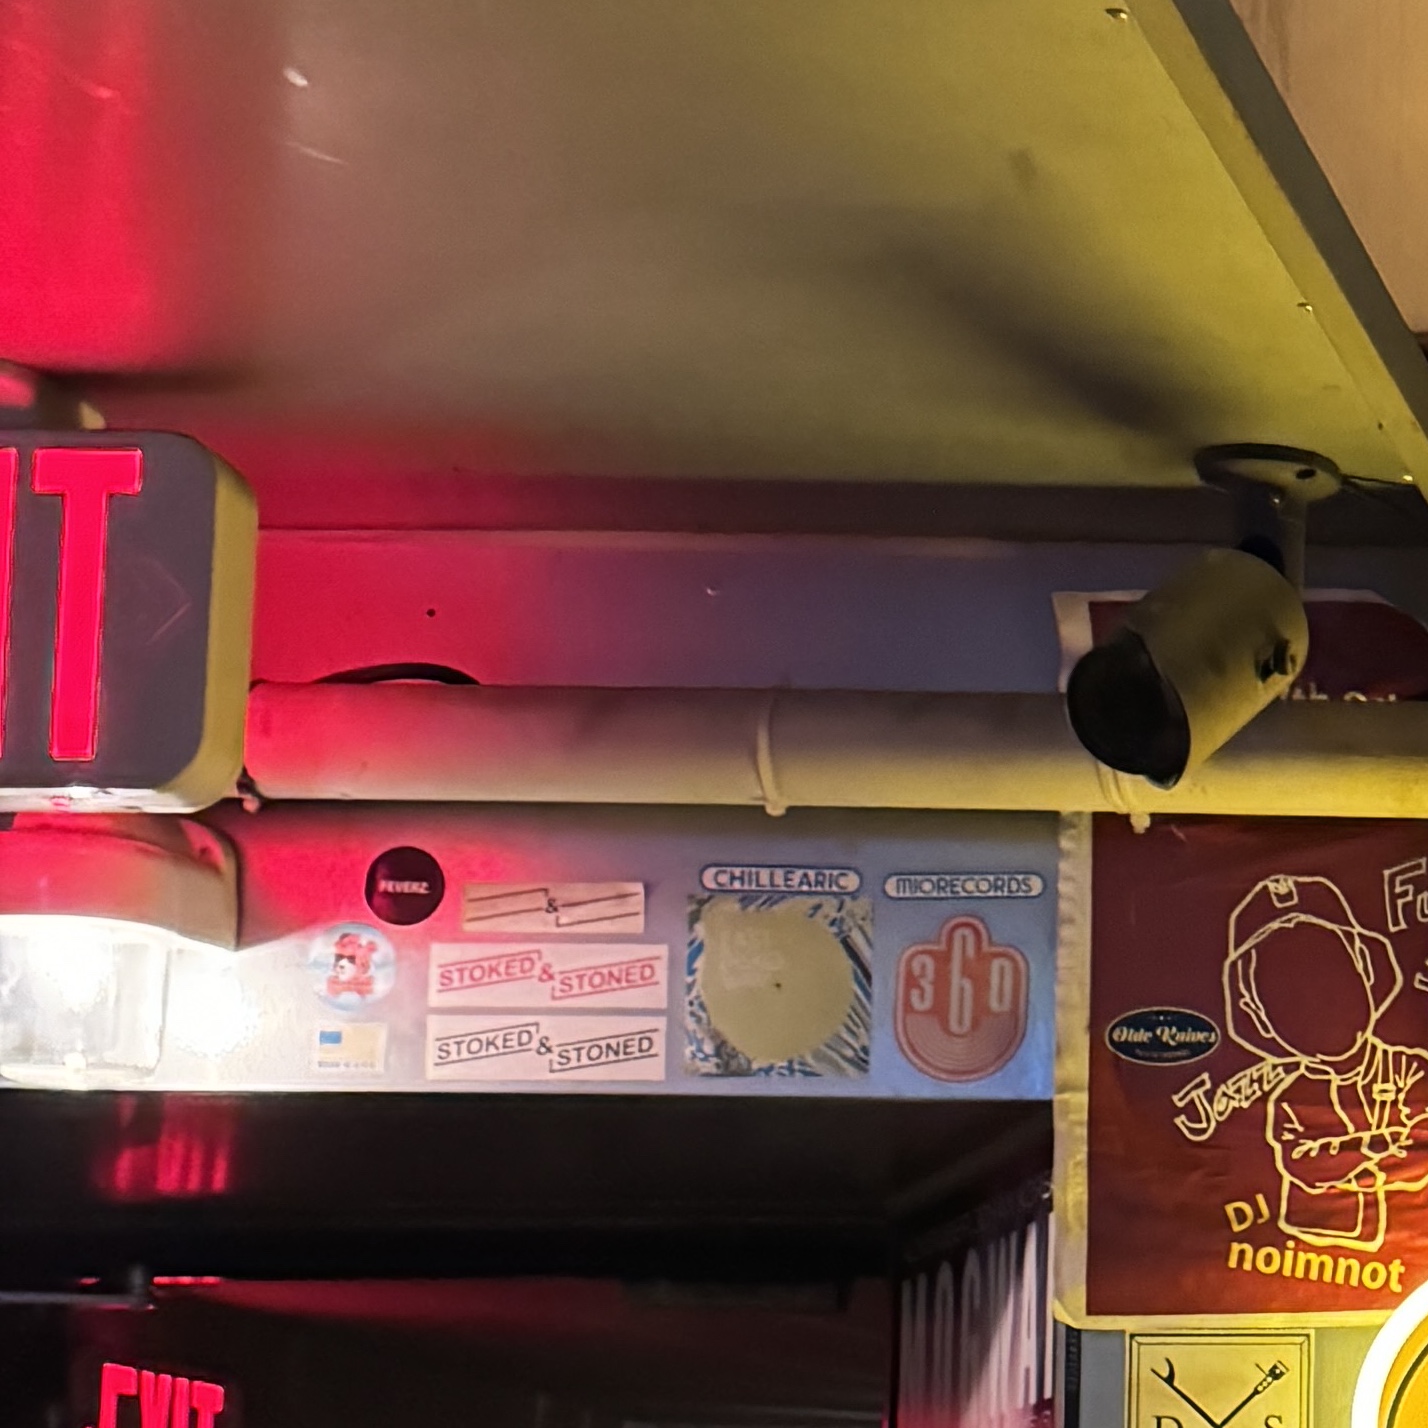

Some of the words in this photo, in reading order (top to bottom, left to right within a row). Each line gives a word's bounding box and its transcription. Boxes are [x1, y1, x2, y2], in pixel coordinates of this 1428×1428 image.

[713, 869, 851, 891] CHILLEARIC
[544, 897, 558, 914] &
[438, 956, 535, 988] STOKED
[538, 966, 555, 983] &
[558, 964, 656, 995] STONED
[909, 926, 1015, 1036] 360
[436, 1029, 534, 1061] STOKED
[536, 1035, 553, 1055] &
[556, 1037, 654, 1067] STONED
[1172, 1058, 1287, 1142] Jazz
[1224, 1193, 1270, 1234] DJ
[1227, 1240, 1405, 1293] noimnot
